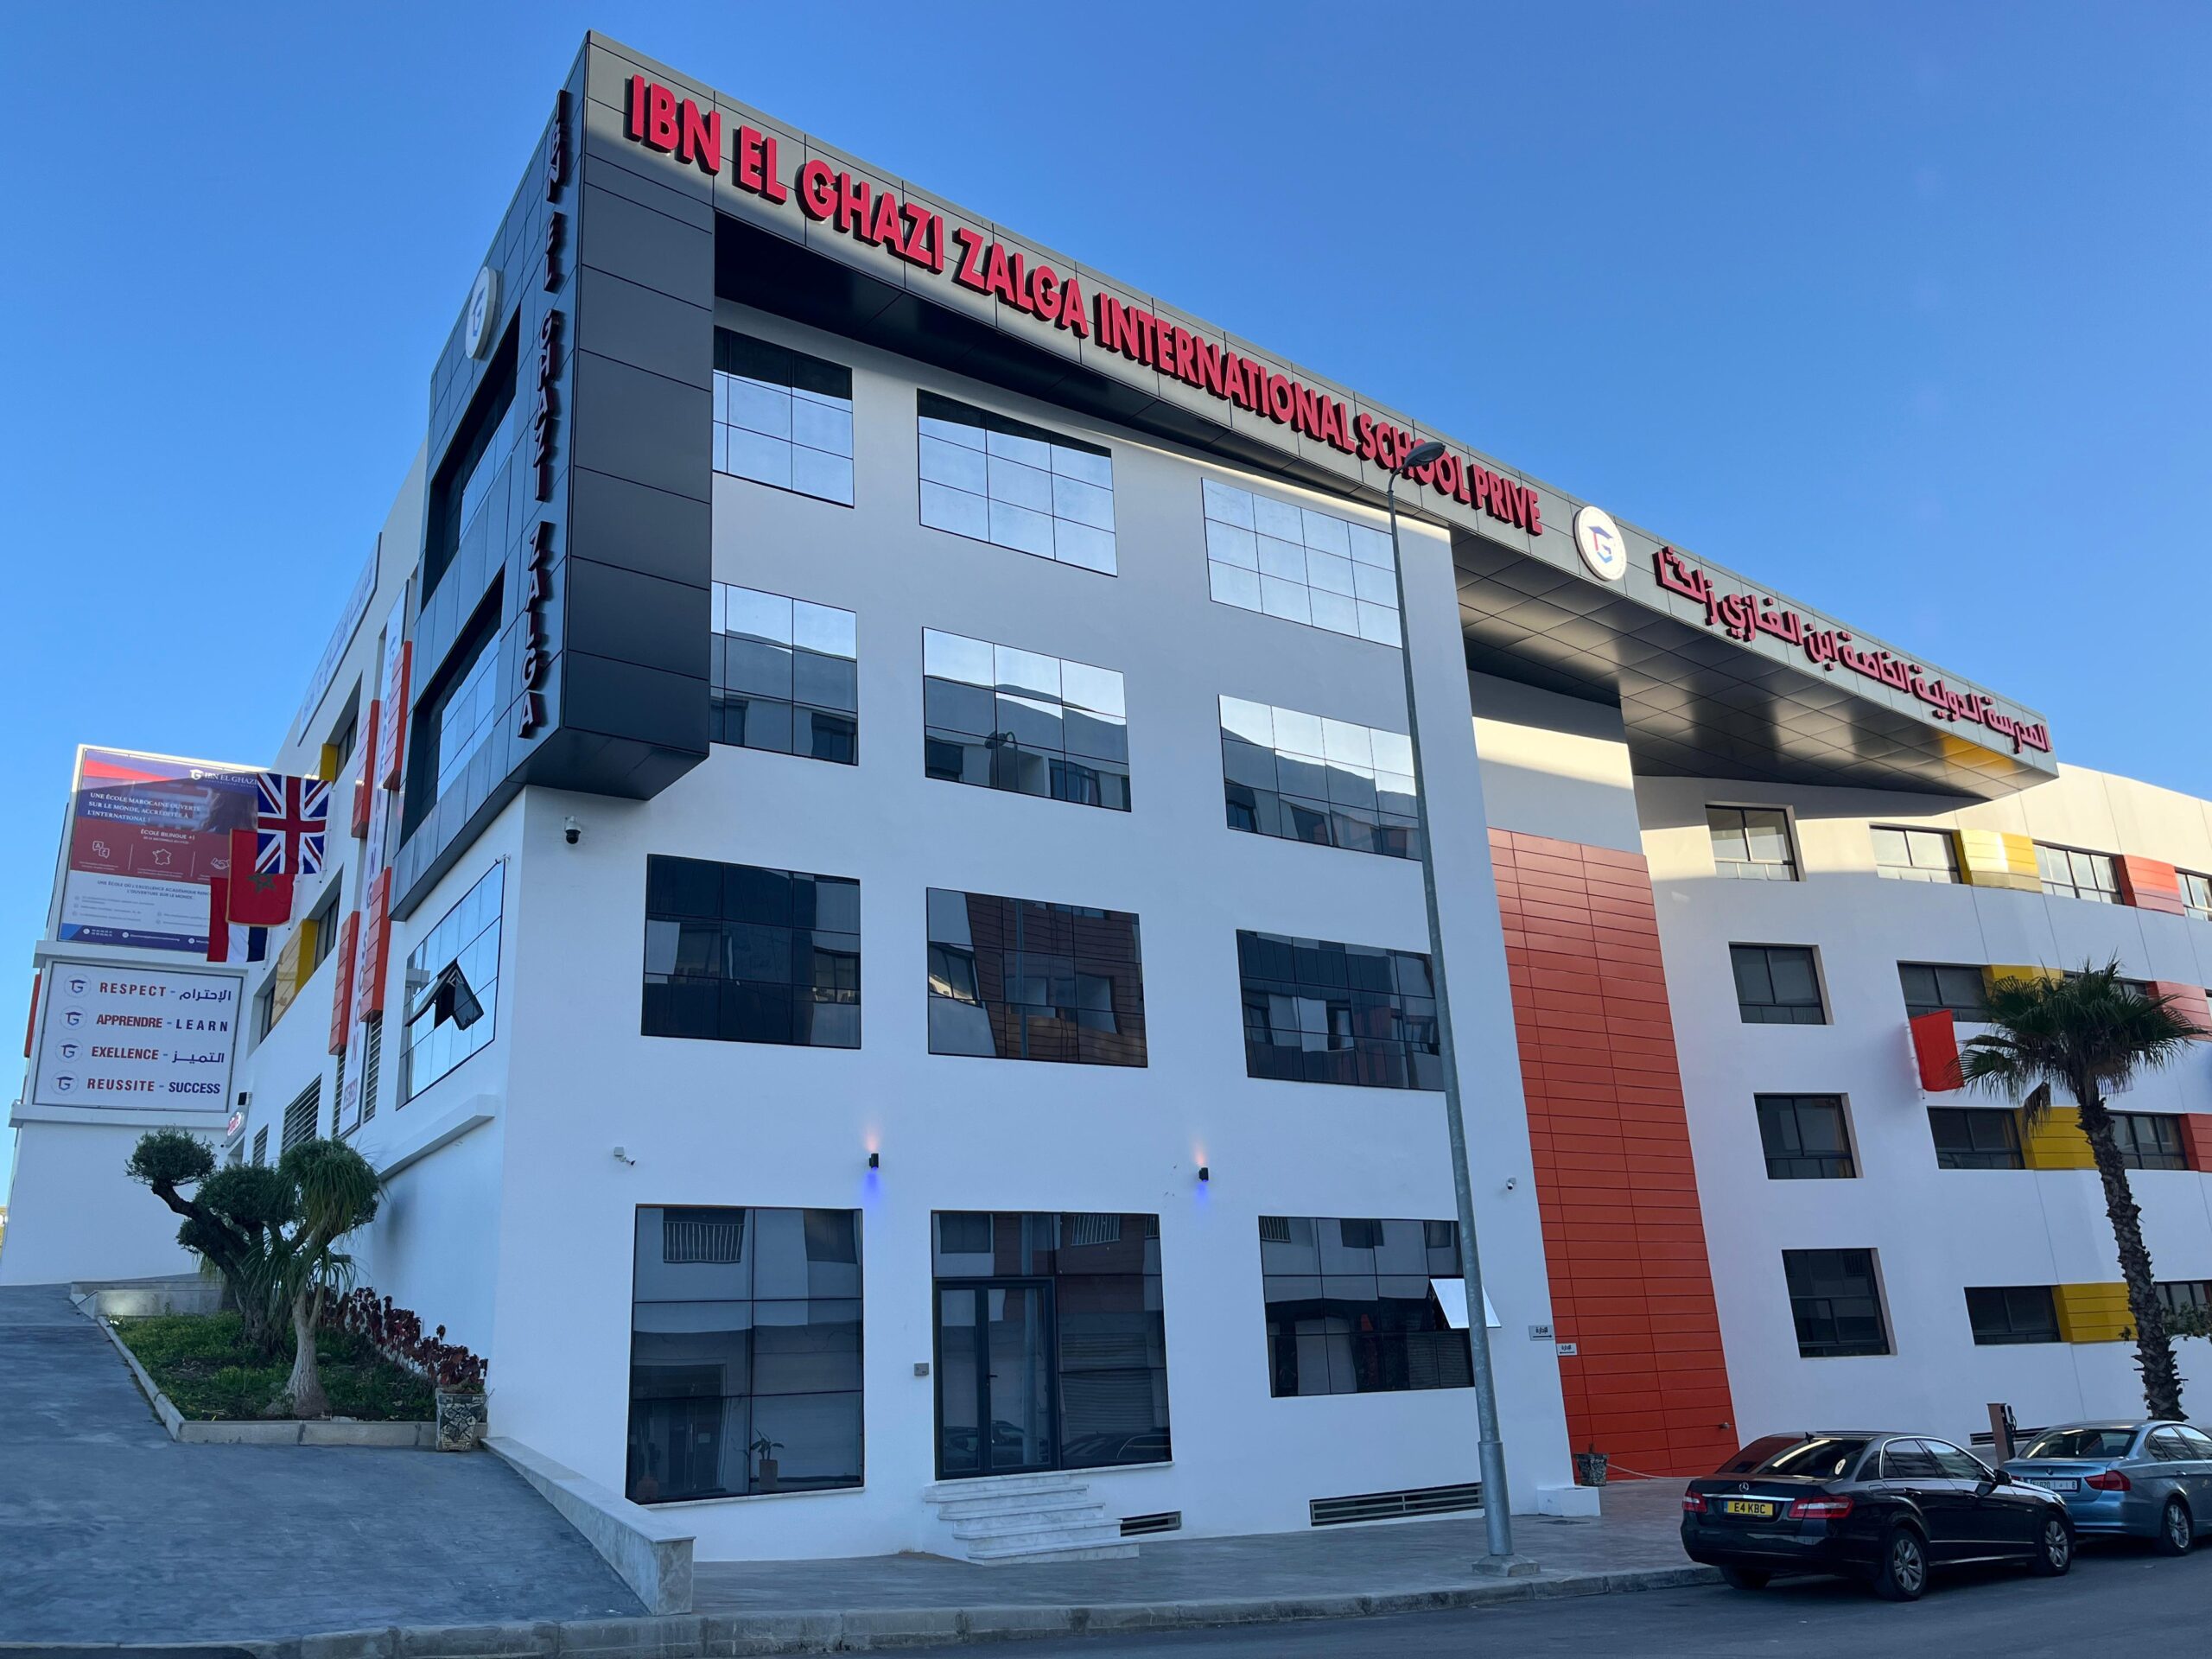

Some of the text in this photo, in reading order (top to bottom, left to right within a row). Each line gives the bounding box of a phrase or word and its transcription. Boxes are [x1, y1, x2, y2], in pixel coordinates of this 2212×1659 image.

[627, 74, 1543, 537] IBN EL GHAZI ZALGA INTERNATIONAL SCHOOL PRIVE
[518, 89, 570, 739] IBN EL GHAZI ZALGA
[1717, 594, 1803, 645] الغازي
[1803, 623, 1839, 672] ابن
[1836, 631, 1911, 694] الخاصة
[1909, 664, 1984, 722] الدولية
[1983, 696, 2052, 754] المدرسة
[87, 810, 146, 823] L'INTERNATIONAL
[105, 793, 127, 803] ÉCOLE
[129, 798, 168, 808] MAROCAINE
[170, 803, 200, 812] OUVERTE
[99, 982, 167, 997] RESPECT
[96, 1014, 163, 1028] APPRENDRE
[175, 1019, 228, 1033] LEARN
[92, 1046, 160, 1060] EXELLENCE
[87, 1078, 155, 1092] REUSSITE
[168, 1082, 221, 1095] SUCCESS
[1734, 1502, 1766, 1515] E4 KBC
